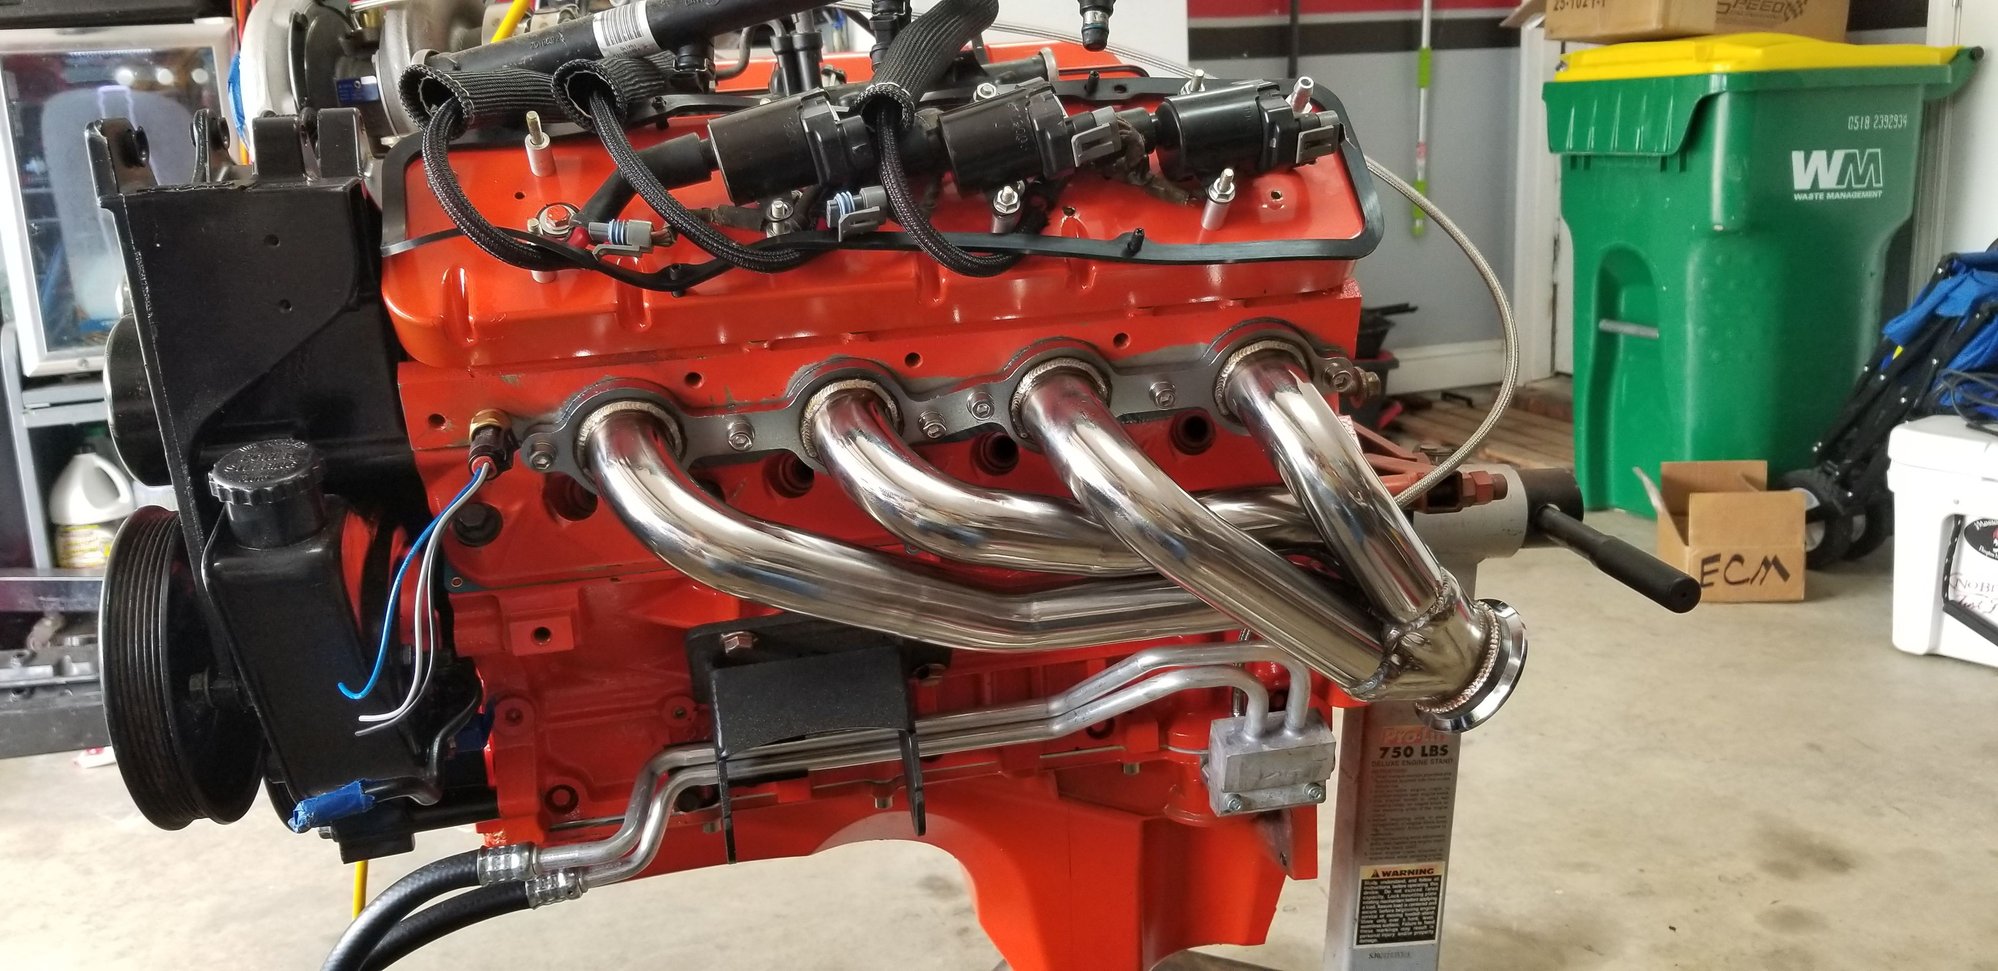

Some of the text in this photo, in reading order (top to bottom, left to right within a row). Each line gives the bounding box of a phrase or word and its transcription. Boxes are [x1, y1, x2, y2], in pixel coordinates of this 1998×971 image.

[1791, 148, 1883, 190] WM
[1794, 190, 1883, 200] WASTE MANAGEMENT
[1700, 553, 1791, 588] ECM
[1379, 745, 1449, 759] 750 LBS
[1381, 868, 1435, 877] WARNING
